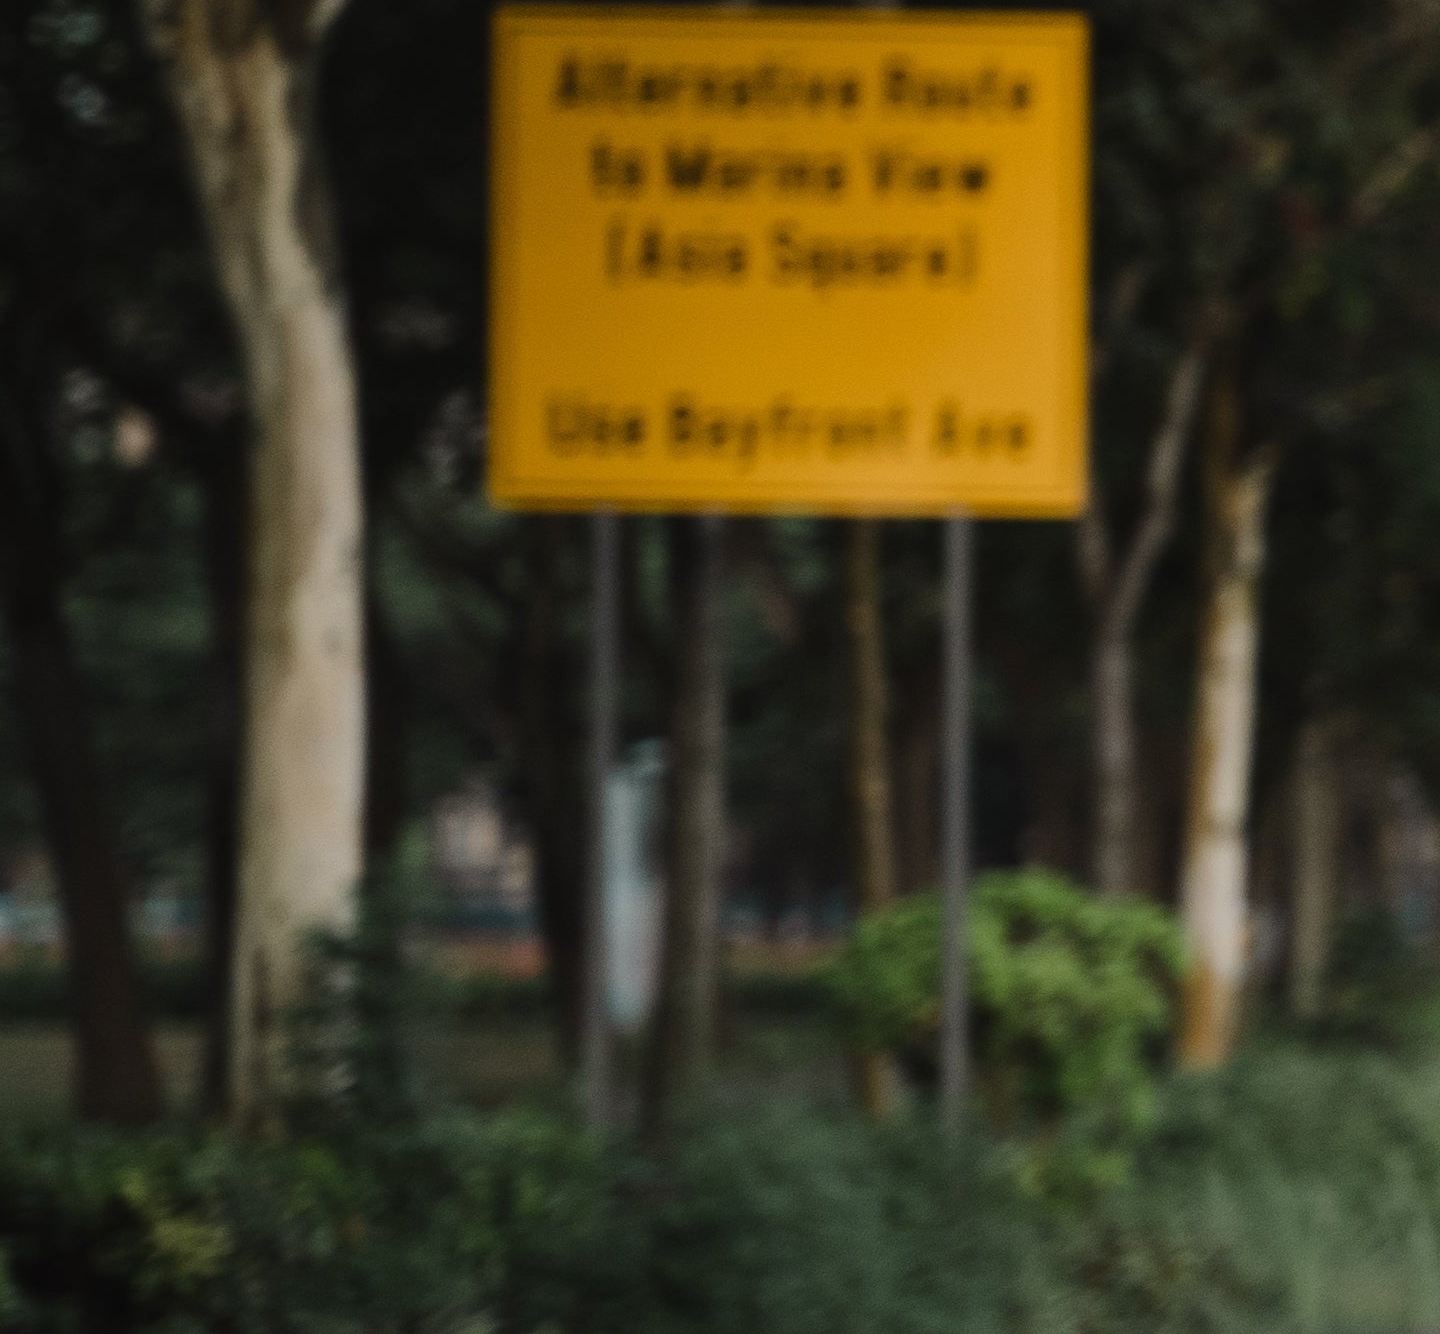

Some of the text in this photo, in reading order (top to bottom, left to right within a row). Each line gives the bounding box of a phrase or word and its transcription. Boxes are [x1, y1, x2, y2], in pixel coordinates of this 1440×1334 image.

[553, 51, 1038, 118] Alternative Route
[662, 137, 850, 200] Marina
